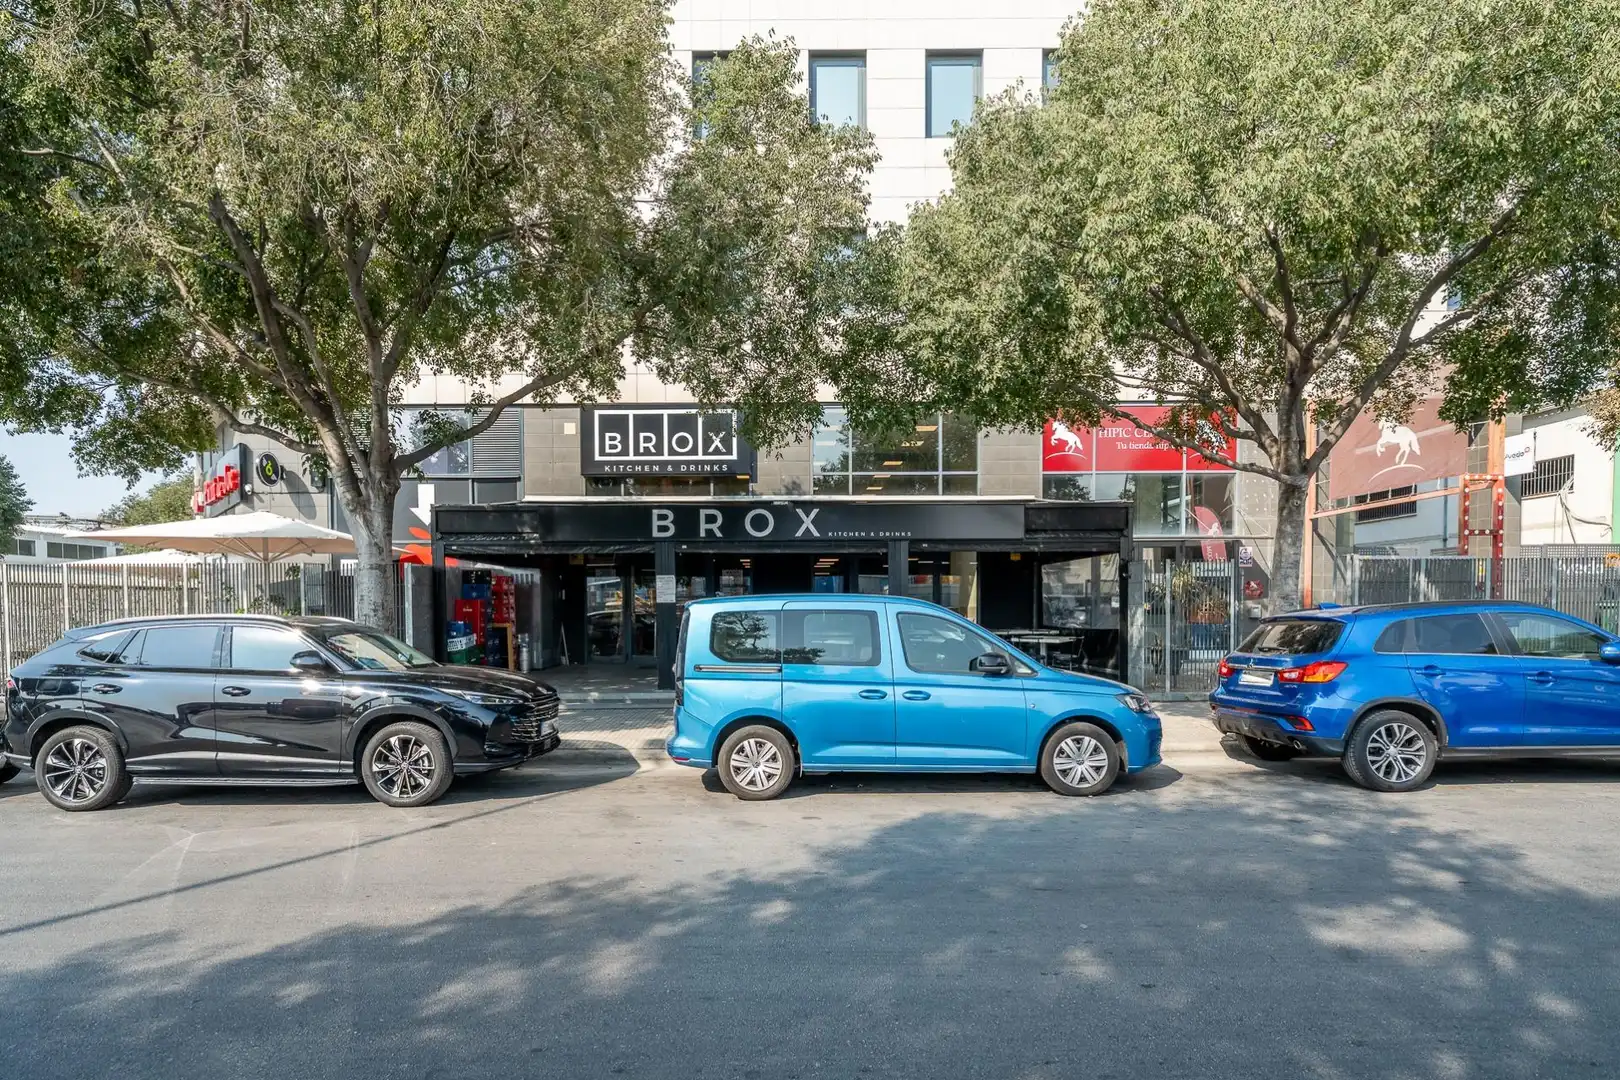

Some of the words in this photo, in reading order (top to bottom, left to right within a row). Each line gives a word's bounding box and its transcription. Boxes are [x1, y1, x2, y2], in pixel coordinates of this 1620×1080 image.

[1099, 427, 1131, 438] HIPIC
[604, 432, 727, 453] BROX
[1116, 441, 1127, 450] Tu
[666, 464, 673, 472] &
[651, 508, 821, 538] BROX
